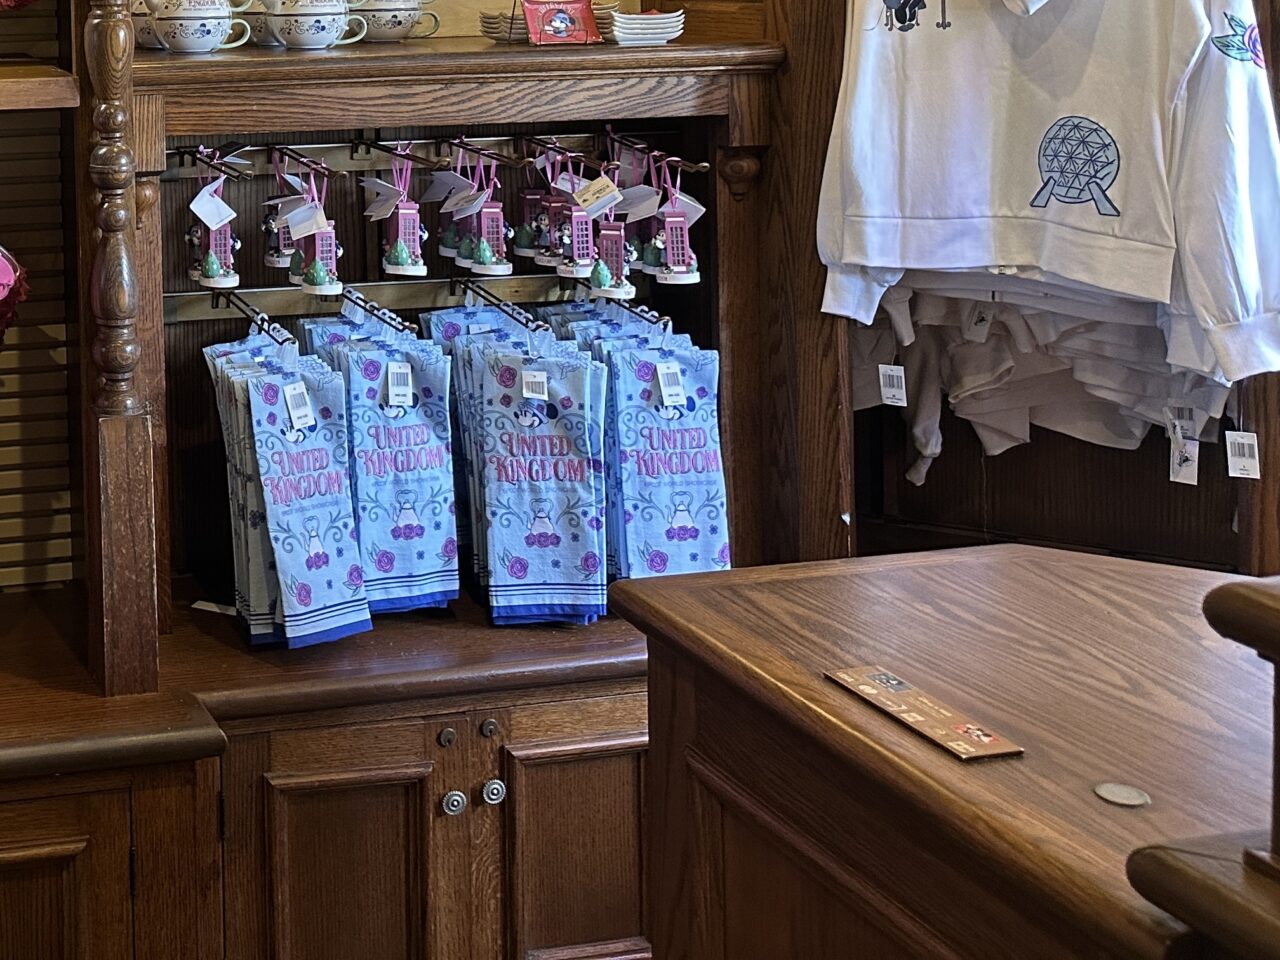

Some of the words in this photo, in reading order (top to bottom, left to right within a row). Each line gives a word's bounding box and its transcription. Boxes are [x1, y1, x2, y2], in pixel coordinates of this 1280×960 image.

[367, 422, 431, 450] UNITED
[500, 431, 572, 458] UNITED
[640, 426, 707, 452] UNITED
[271, 447, 330, 477] UNITED
[357, 445, 444, 479] KINGDOM
[489, 454, 585, 486] KINGDOM
[629, 448, 720, 480] KINGDOM
[263, 471, 343, 507] KINGDOM
